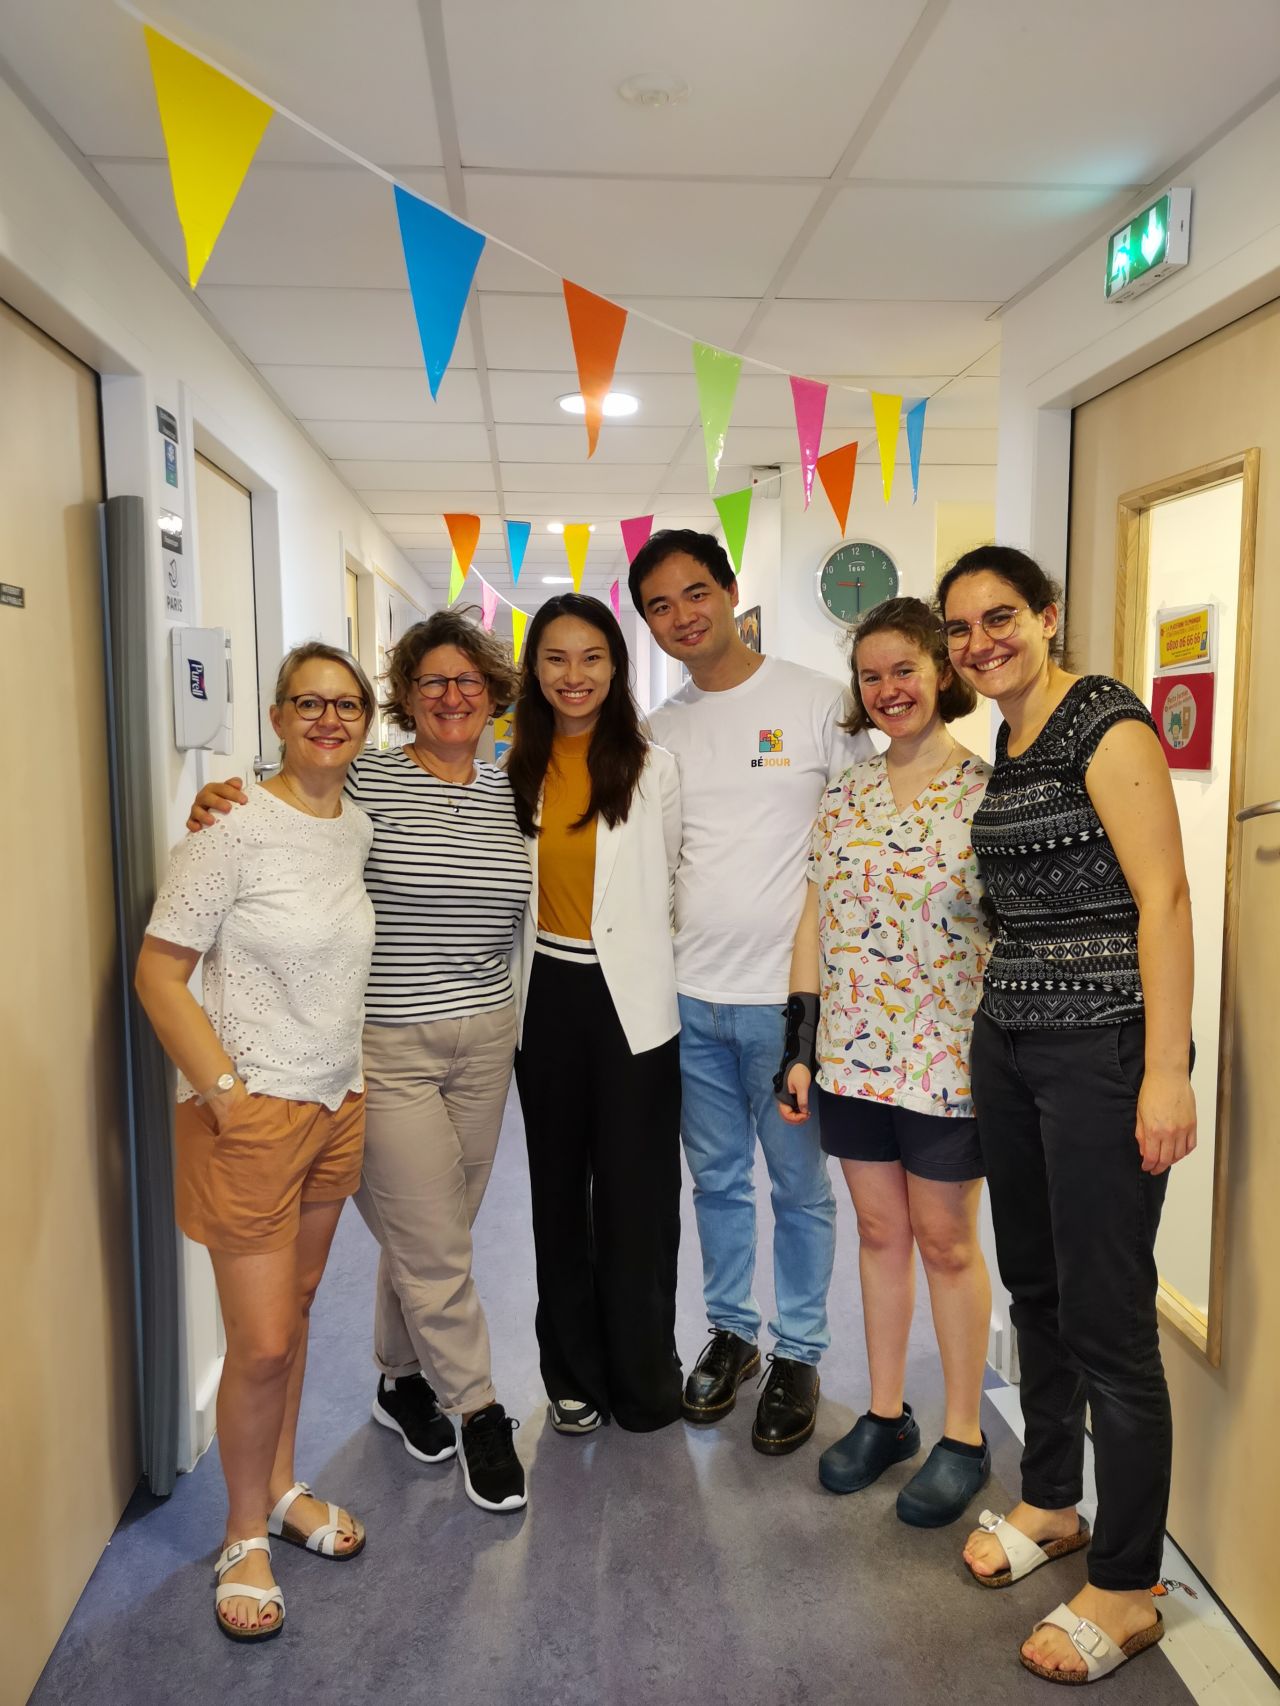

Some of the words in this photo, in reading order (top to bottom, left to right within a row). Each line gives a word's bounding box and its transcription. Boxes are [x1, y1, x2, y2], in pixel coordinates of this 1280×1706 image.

[851, 547, 860, 556] 12
[837, 552, 844, 561] 11
[826, 565, 834, 574] 10
[881, 561, 887, 570] 2
[888, 577, 894, 586] 3
[822, 583, 827, 591] 9
[166, 595, 183, 613] PARIS
[827, 599, 832, 608] 8
[841, 610, 846, 619] 7
[191, 663, 204, 697] Purell
